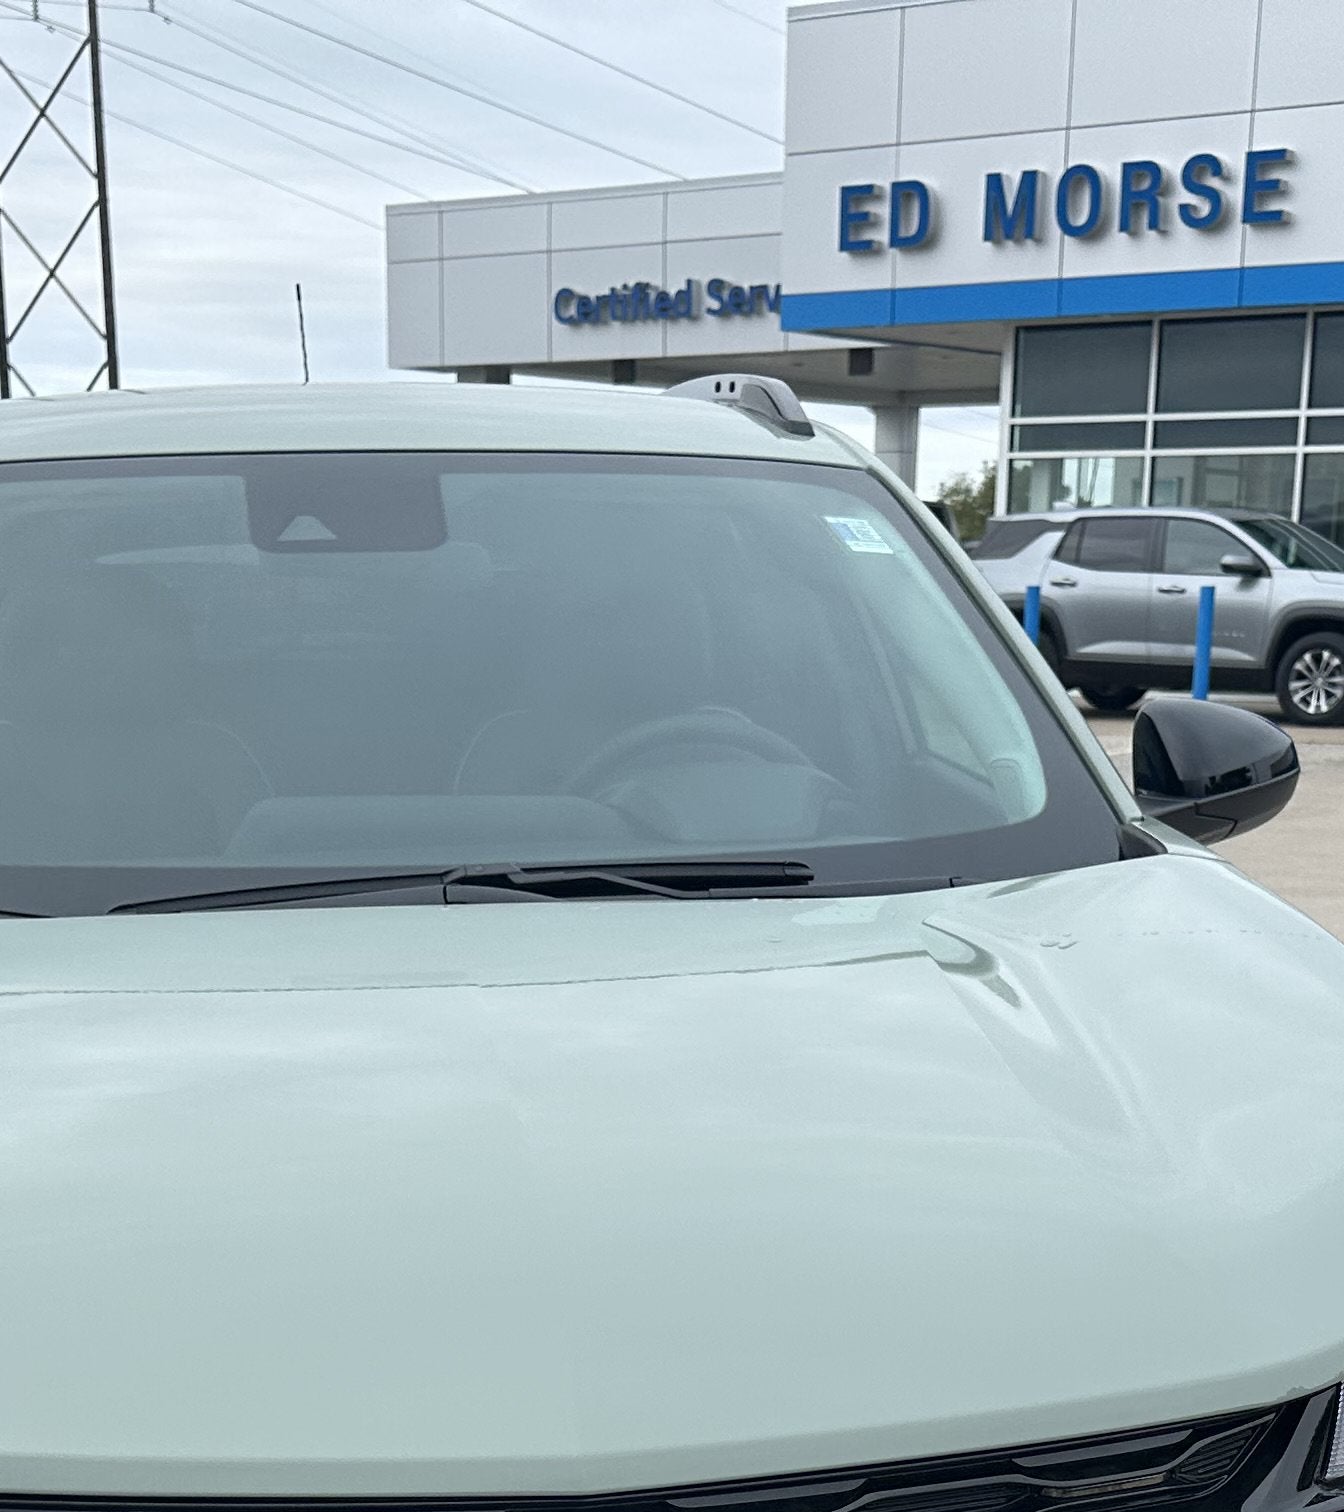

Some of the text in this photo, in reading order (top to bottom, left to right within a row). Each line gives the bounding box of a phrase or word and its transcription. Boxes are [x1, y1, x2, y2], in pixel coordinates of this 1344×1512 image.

[838, 148, 1293, 253] ED MORSE
[554, 278, 696, 325] Certified
